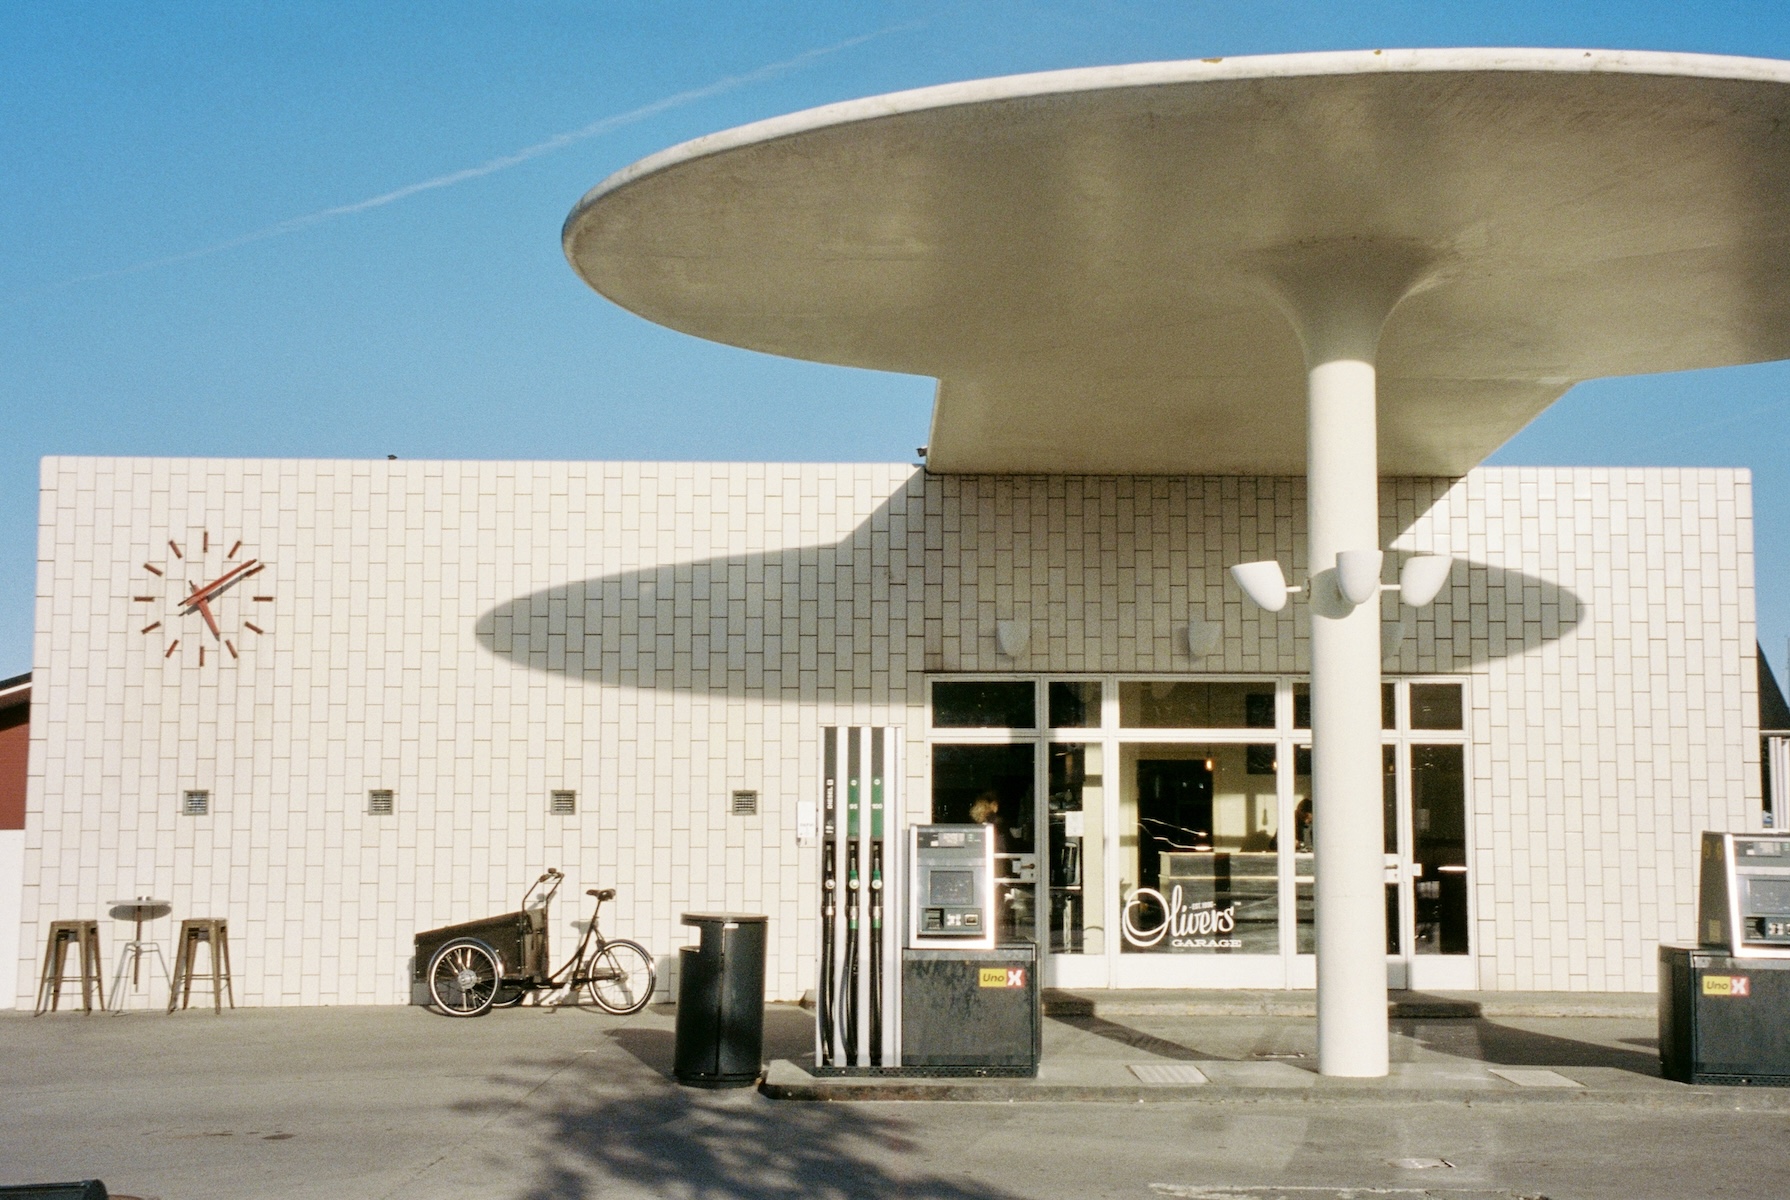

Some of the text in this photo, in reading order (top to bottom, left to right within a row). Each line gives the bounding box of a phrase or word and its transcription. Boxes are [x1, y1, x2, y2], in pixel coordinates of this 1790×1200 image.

[826, 786, 834, 810] DIESEL
[1122, 884, 1235, 947] Olivers
[1171, 938, 1242, 948] GARAGE
[983, 969, 1023, 986] Uno X
[1706, 977, 1747, 995] Uno X
